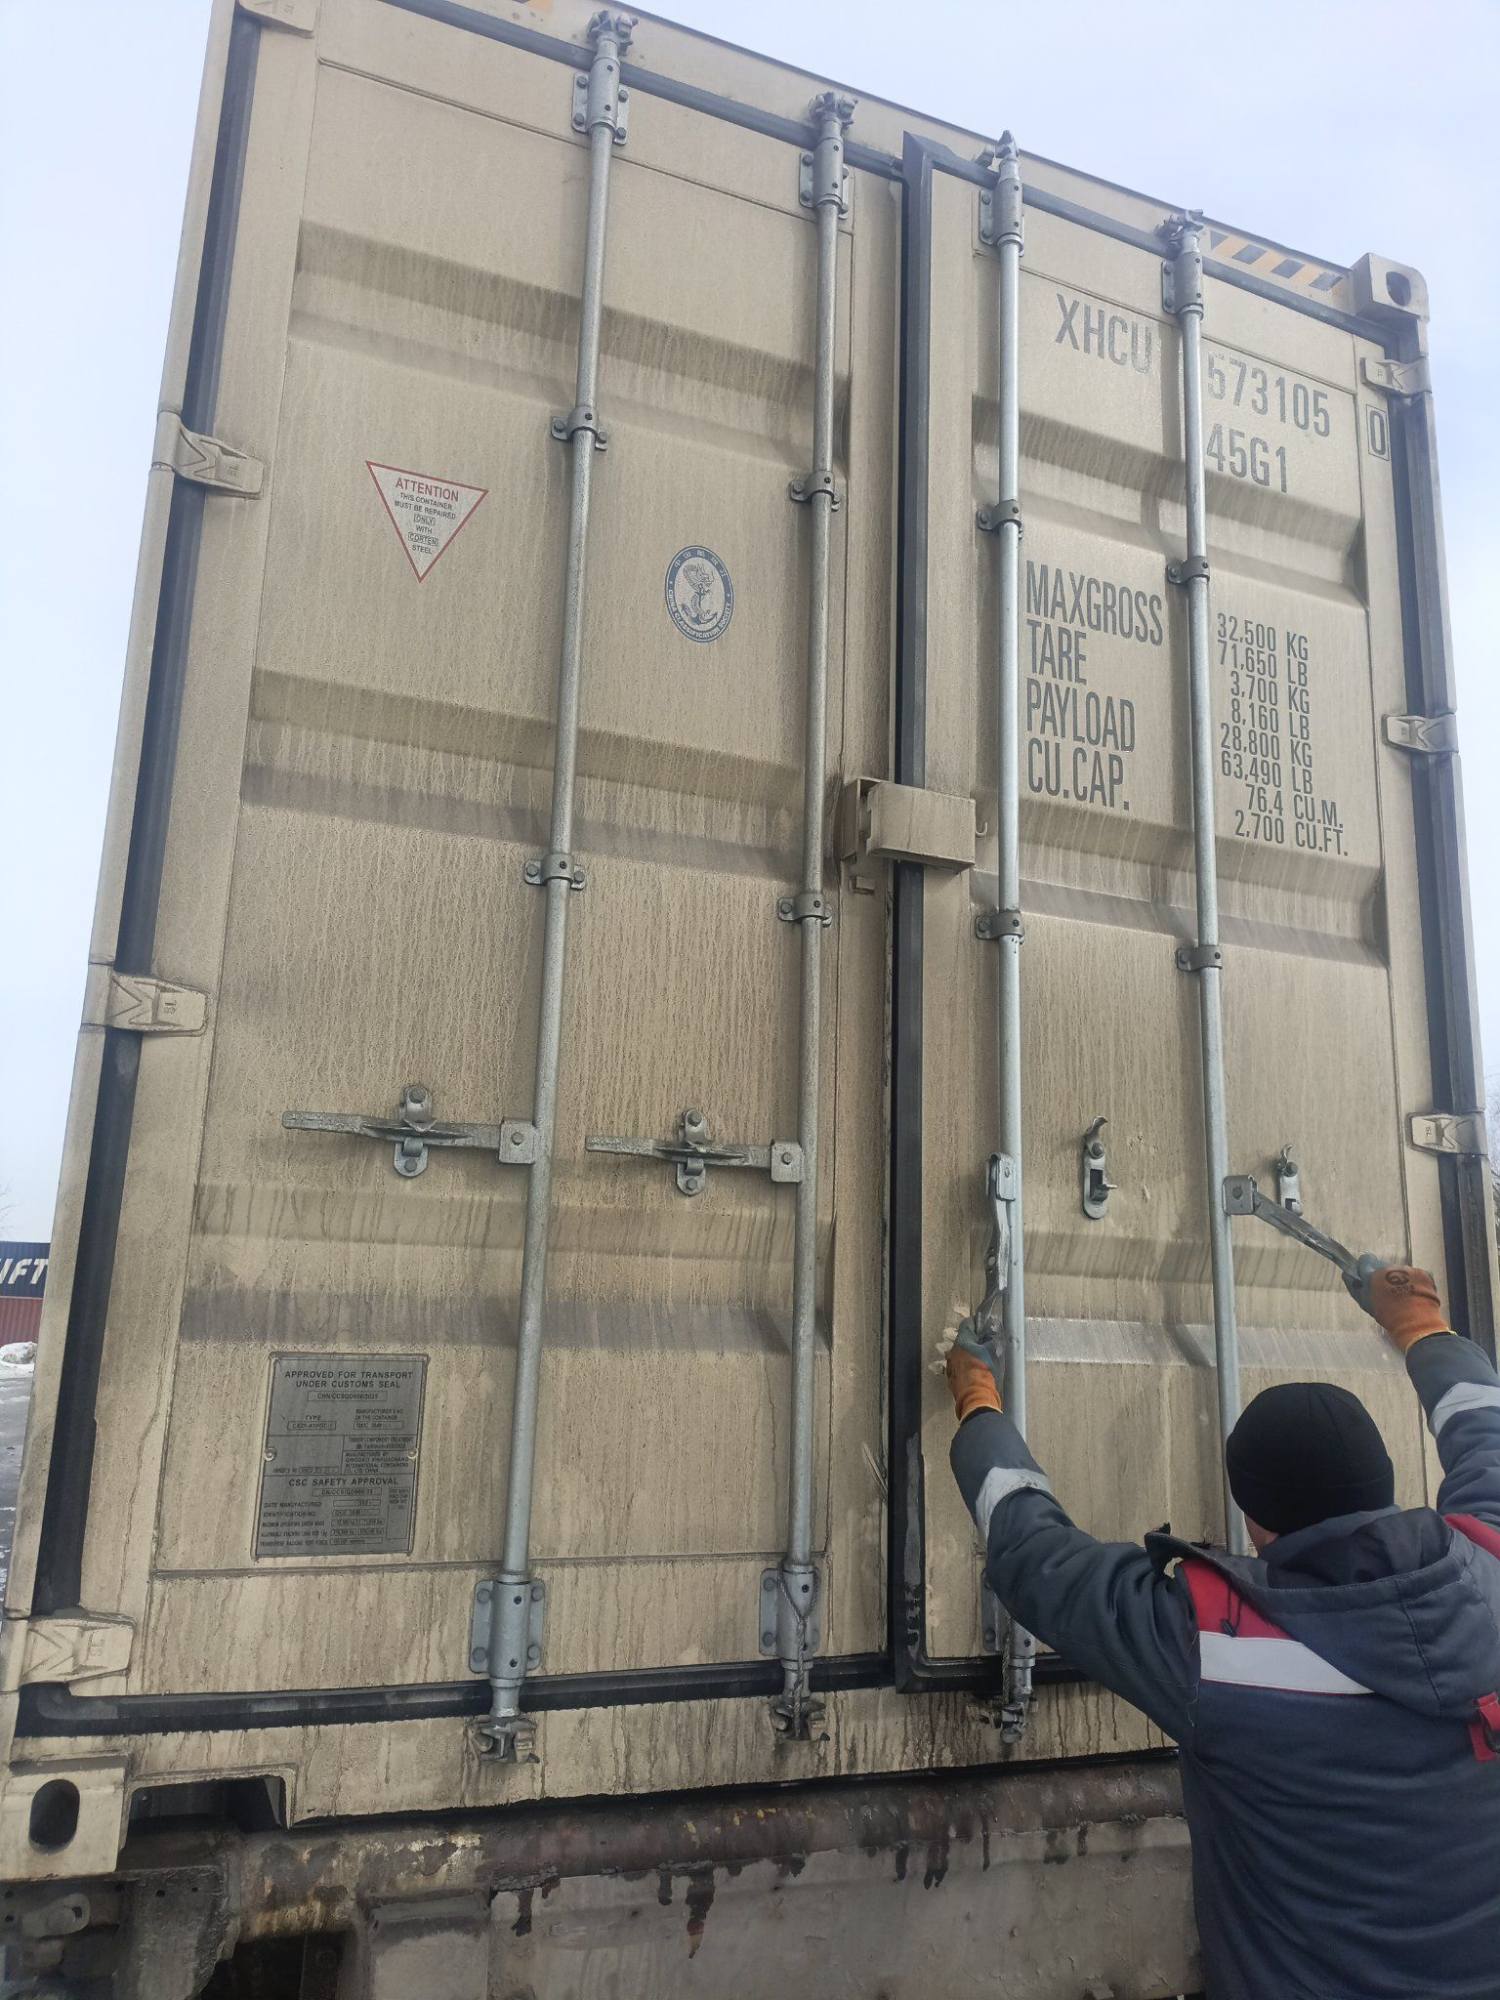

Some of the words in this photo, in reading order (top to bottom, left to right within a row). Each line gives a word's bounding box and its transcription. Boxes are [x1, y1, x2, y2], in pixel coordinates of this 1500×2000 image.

[1055, 293, 1153, 375] XHCU
[1206, 351, 1331, 437] 573105
[1370, 409, 1386, 457] 0
[1206, 422, 1287, 494] 45G1
[394, 500, 412, 510] MUST
[413, 504, 423, 513] BE
[424, 507, 456, 520] REPAIRED
[395, 477, 459, 502] ATTENTION
[400, 492, 415, 502] THIS
[415, 496, 453, 510] CONTAINER
[411, 544, 432, 555] STEEL
[415, 524, 433, 534] WITH
[1026, 560, 1164, 647] MAXGROSS
[1026, 618, 1088, 685] TARE
[1217, 612, 1277, 652] 32,500
[1286, 631, 1309, 661] KG
[1217, 639, 1277, 679] 71,650
[1287, 661, 1308, 688] LB
[1230, 671, 1278, 706] 3,700
[1288, 685, 1310, 714] KG
[1026, 677, 1136, 753] PAYLOAD
[1231, 698, 1279, 734] 8,160
[1289, 712, 1310, 740] LB
[1220, 723, 1280, 760] 28,800
[1290, 738, 1313, 768] KG
[1026, 737, 1130, 811] CU.CAP.
[1221, 750, 1281, 788] 63,490
[1292, 766, 1313, 794] LB
[1245, 784, 1284, 817] 76.4
[1293, 794, 1344, 829] CU.M.
[1234, 810, 1285, 844] 2,700
[1295, 821, 1349, 857] CU.FT.
[0, 1258, 49, 1285] IFT
[285, 1371, 334, 1379] APPROVED
[338, 1371, 357, 1379] FOR
[361, 1371, 414, 1380] TRANSPORT
[296, 1380, 327, 1388] UNDER
[331, 1380, 374, 1388] CUSTOMS
[378, 1380, 401, 1389] SEAL
[288, 1478, 308, 1487] CSC
[312, 1478, 348, 1487] SAFETY
[351, 1477, 399, 1486] APPROVAL
